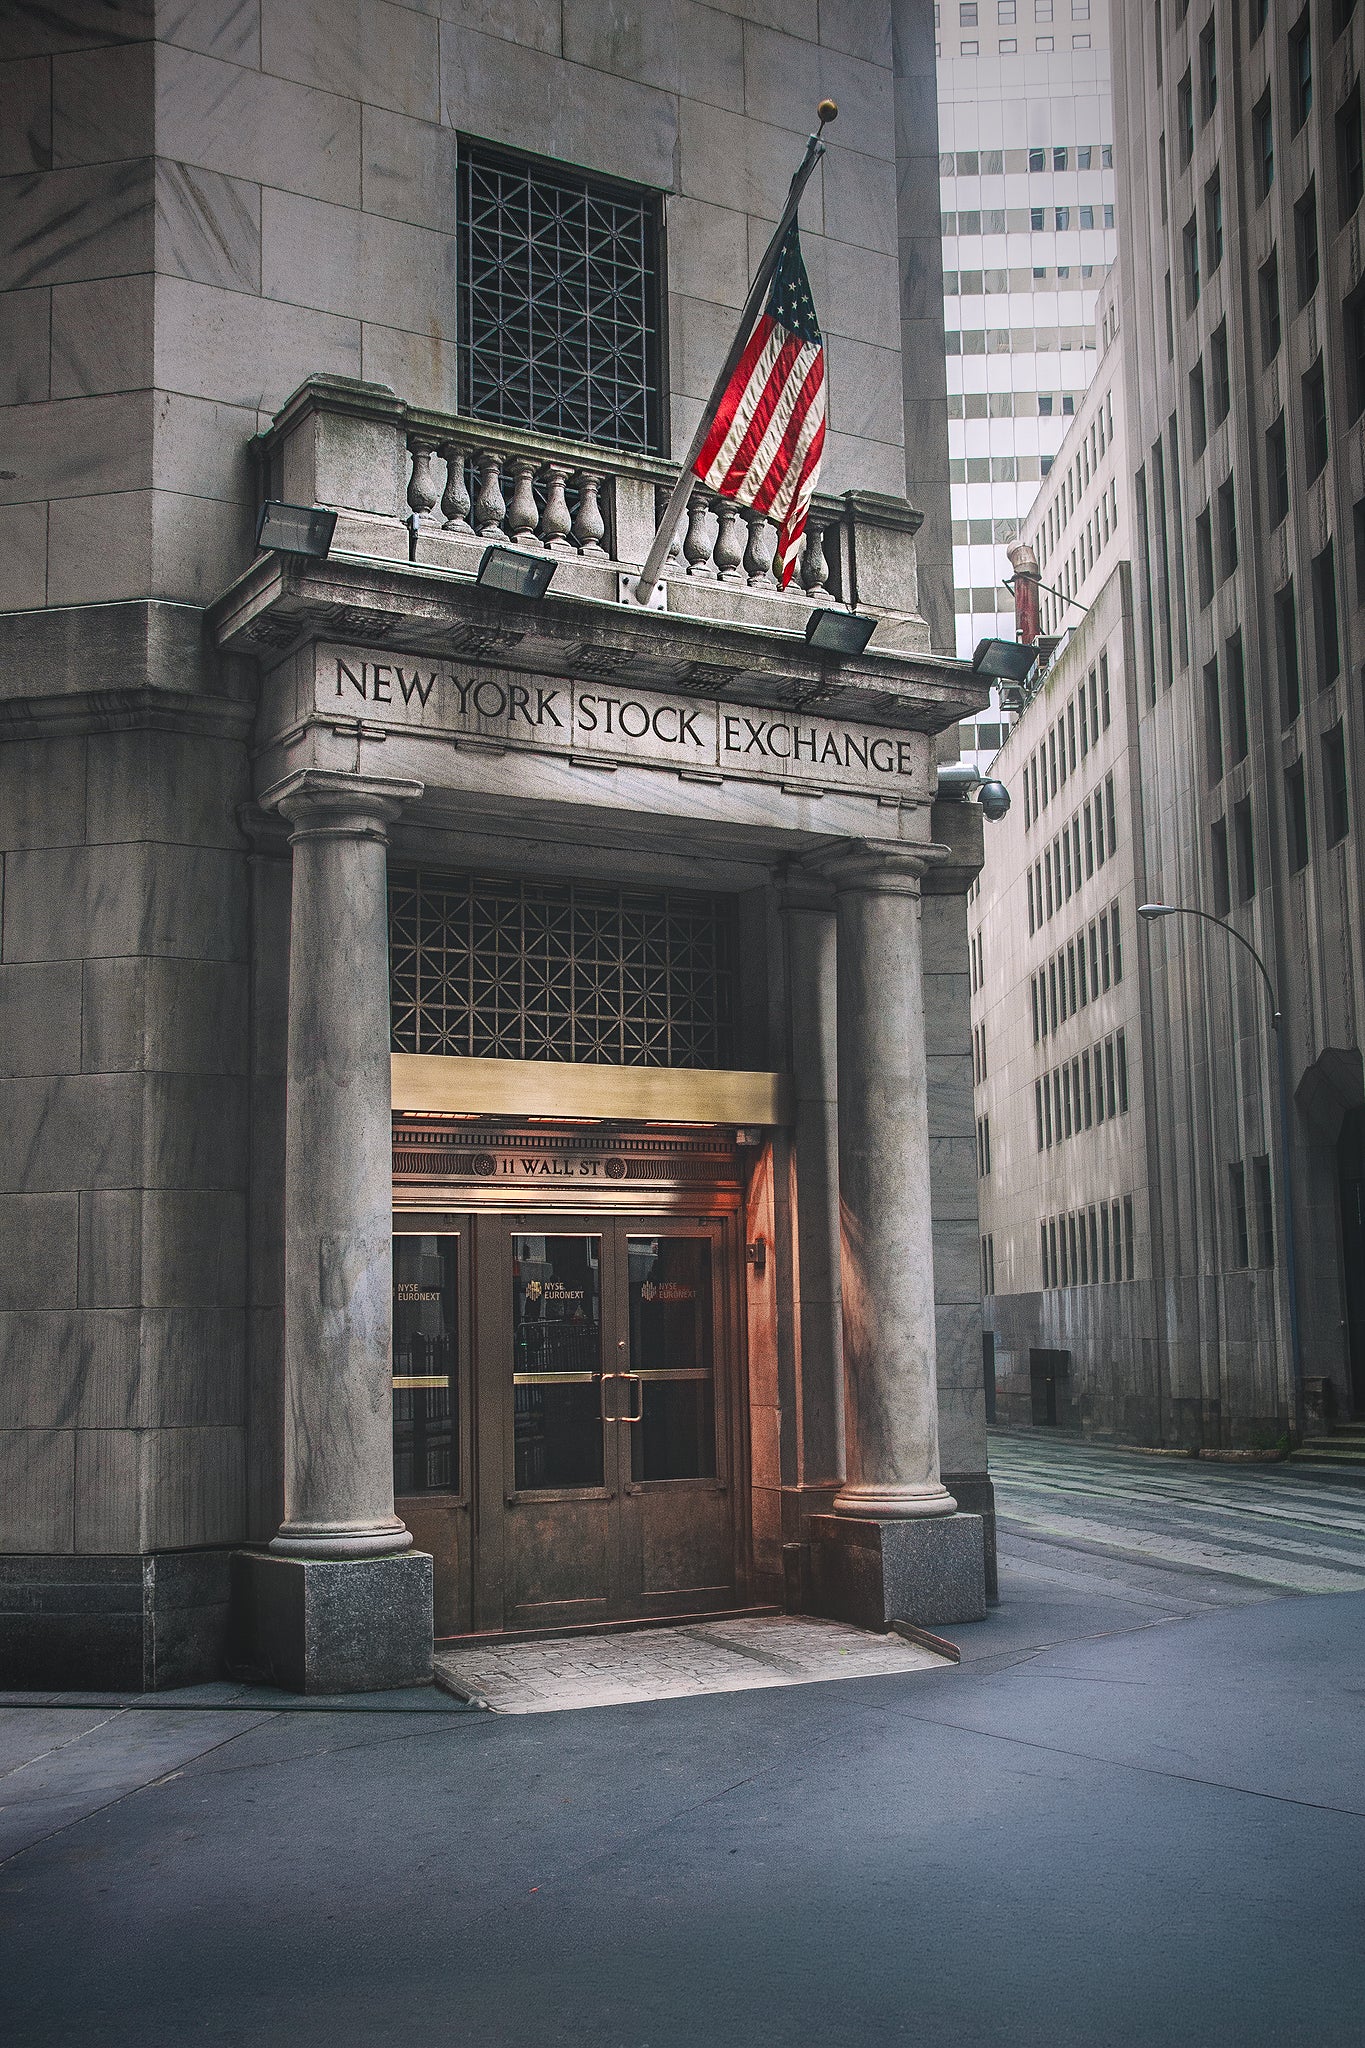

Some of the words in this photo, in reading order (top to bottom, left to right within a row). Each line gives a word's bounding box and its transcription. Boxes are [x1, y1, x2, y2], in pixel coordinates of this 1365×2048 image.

[335, 657, 438, 709] NEW
[450, 675, 565, 728] YORK
[577, 693, 706, 747] STOCK
[722, 714, 914, 776] EXCHANGE
[502, 1158, 515, 1174] 11
[520, 1158, 574, 1176] WALL
[579, 1160, 601, 1176] ST
[397, 1283, 419, 1292] NYSE
[544, 1282, 564, 1291] NYSE
[659, 1282, 678, 1290] NYSE
[397, 1292, 441, 1301] EURONEXT
[544, 1290, 585, 1299] EURONEXT
[659, 1290, 697, 1299] EURONEXT
